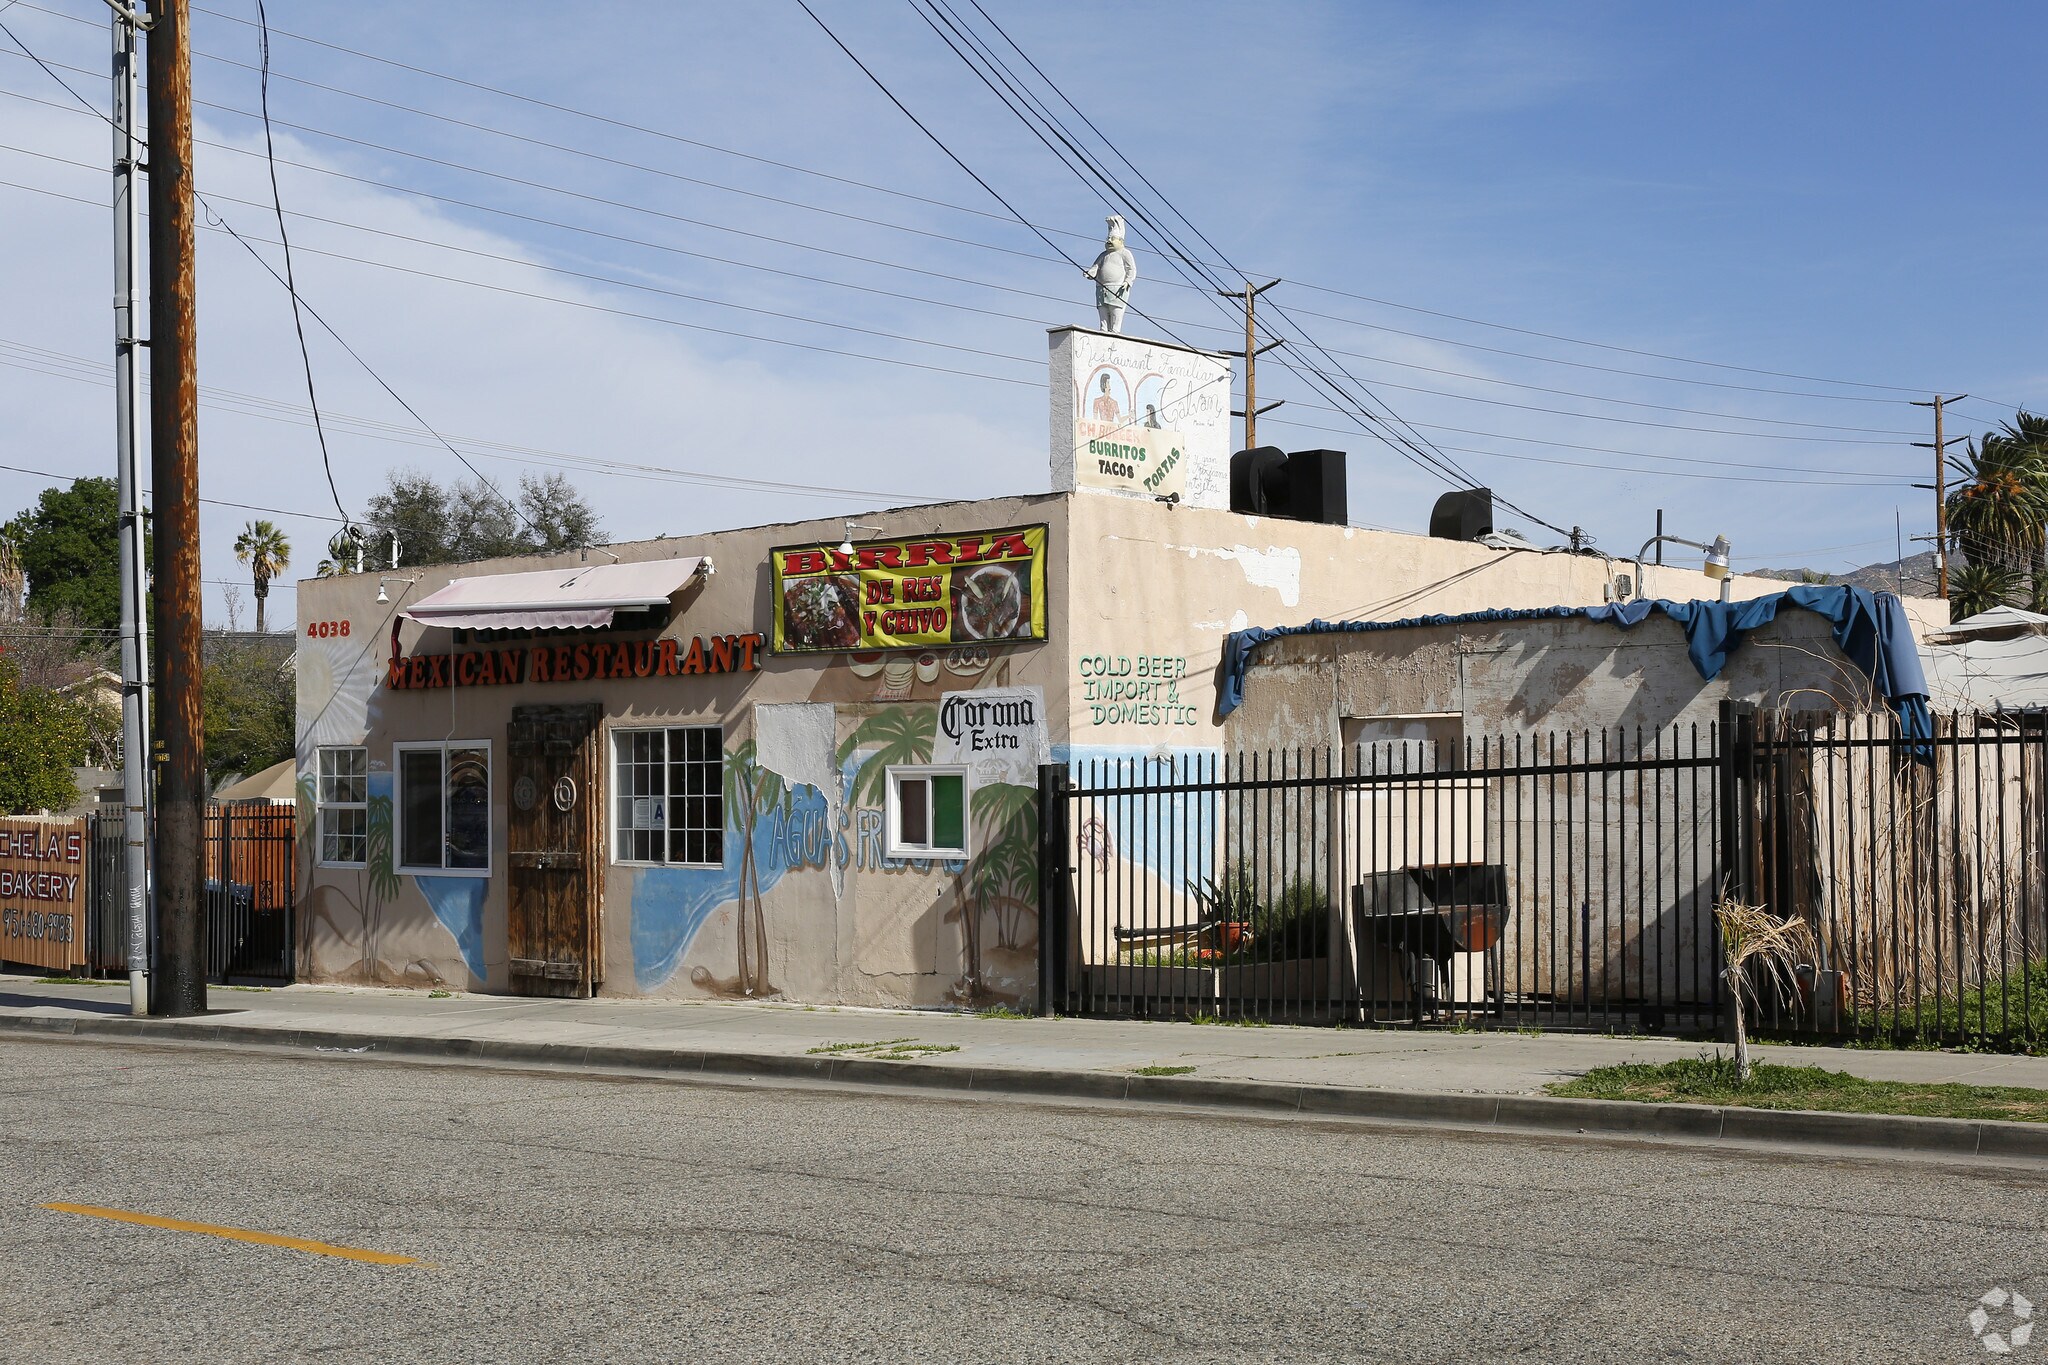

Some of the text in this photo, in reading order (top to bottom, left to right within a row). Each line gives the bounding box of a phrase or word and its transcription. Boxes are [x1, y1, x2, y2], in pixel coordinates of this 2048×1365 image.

[1089, 440, 1146, 461] BURRITOS
[1098, 459, 1134, 479] TACOS
[1143, 447, 1180, 492] TORTAS
[782, 532, 1033, 576] BIRRIA
[866, 575, 942, 605] DE RES
[307, 620, 351, 638] 4038
[863, 607, 947, 636] Y CHIVO
[386, 633, 762, 690] MEXICAN RESTAURANT
[1078, 654, 1186, 678] COLD BEER
[1083, 679, 1179, 703] IMPORT &
[941, 695, 1034, 745] Corona
[1090, 703, 1197, 725] DOMESTIC
[971, 729, 1019, 751] Extra
[654, 804, 664, 820] A
[0, 831, 81, 863] CHELA'S
[1, 870, 79, 901] BAKERY
